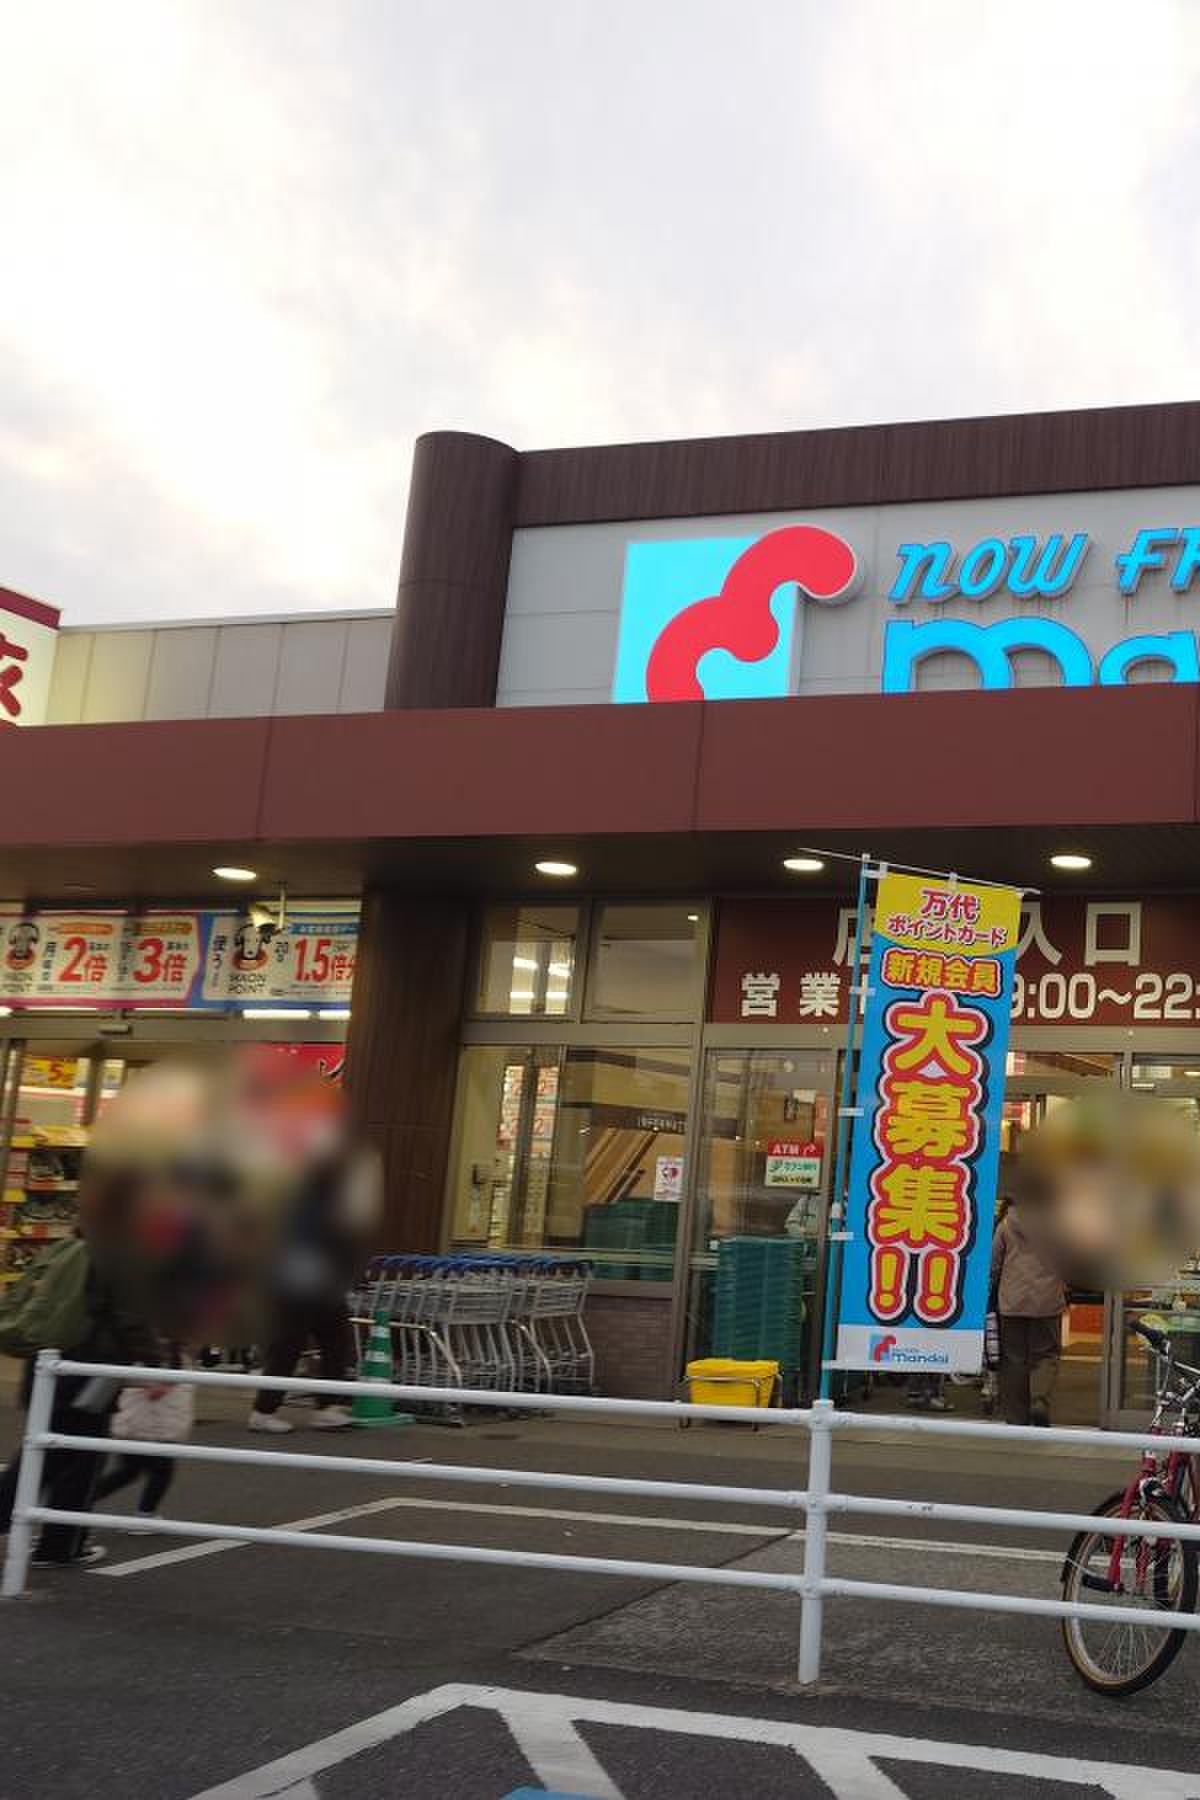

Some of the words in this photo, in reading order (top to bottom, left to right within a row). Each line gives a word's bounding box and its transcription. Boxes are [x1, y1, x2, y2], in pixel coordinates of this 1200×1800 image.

[921, 890, 978, 919] 万代
[887, 914, 1008, 946] ポイントカード
[885, 951, 997, 994] 新規会員
[772, 1143, 800, 1154] ATM
